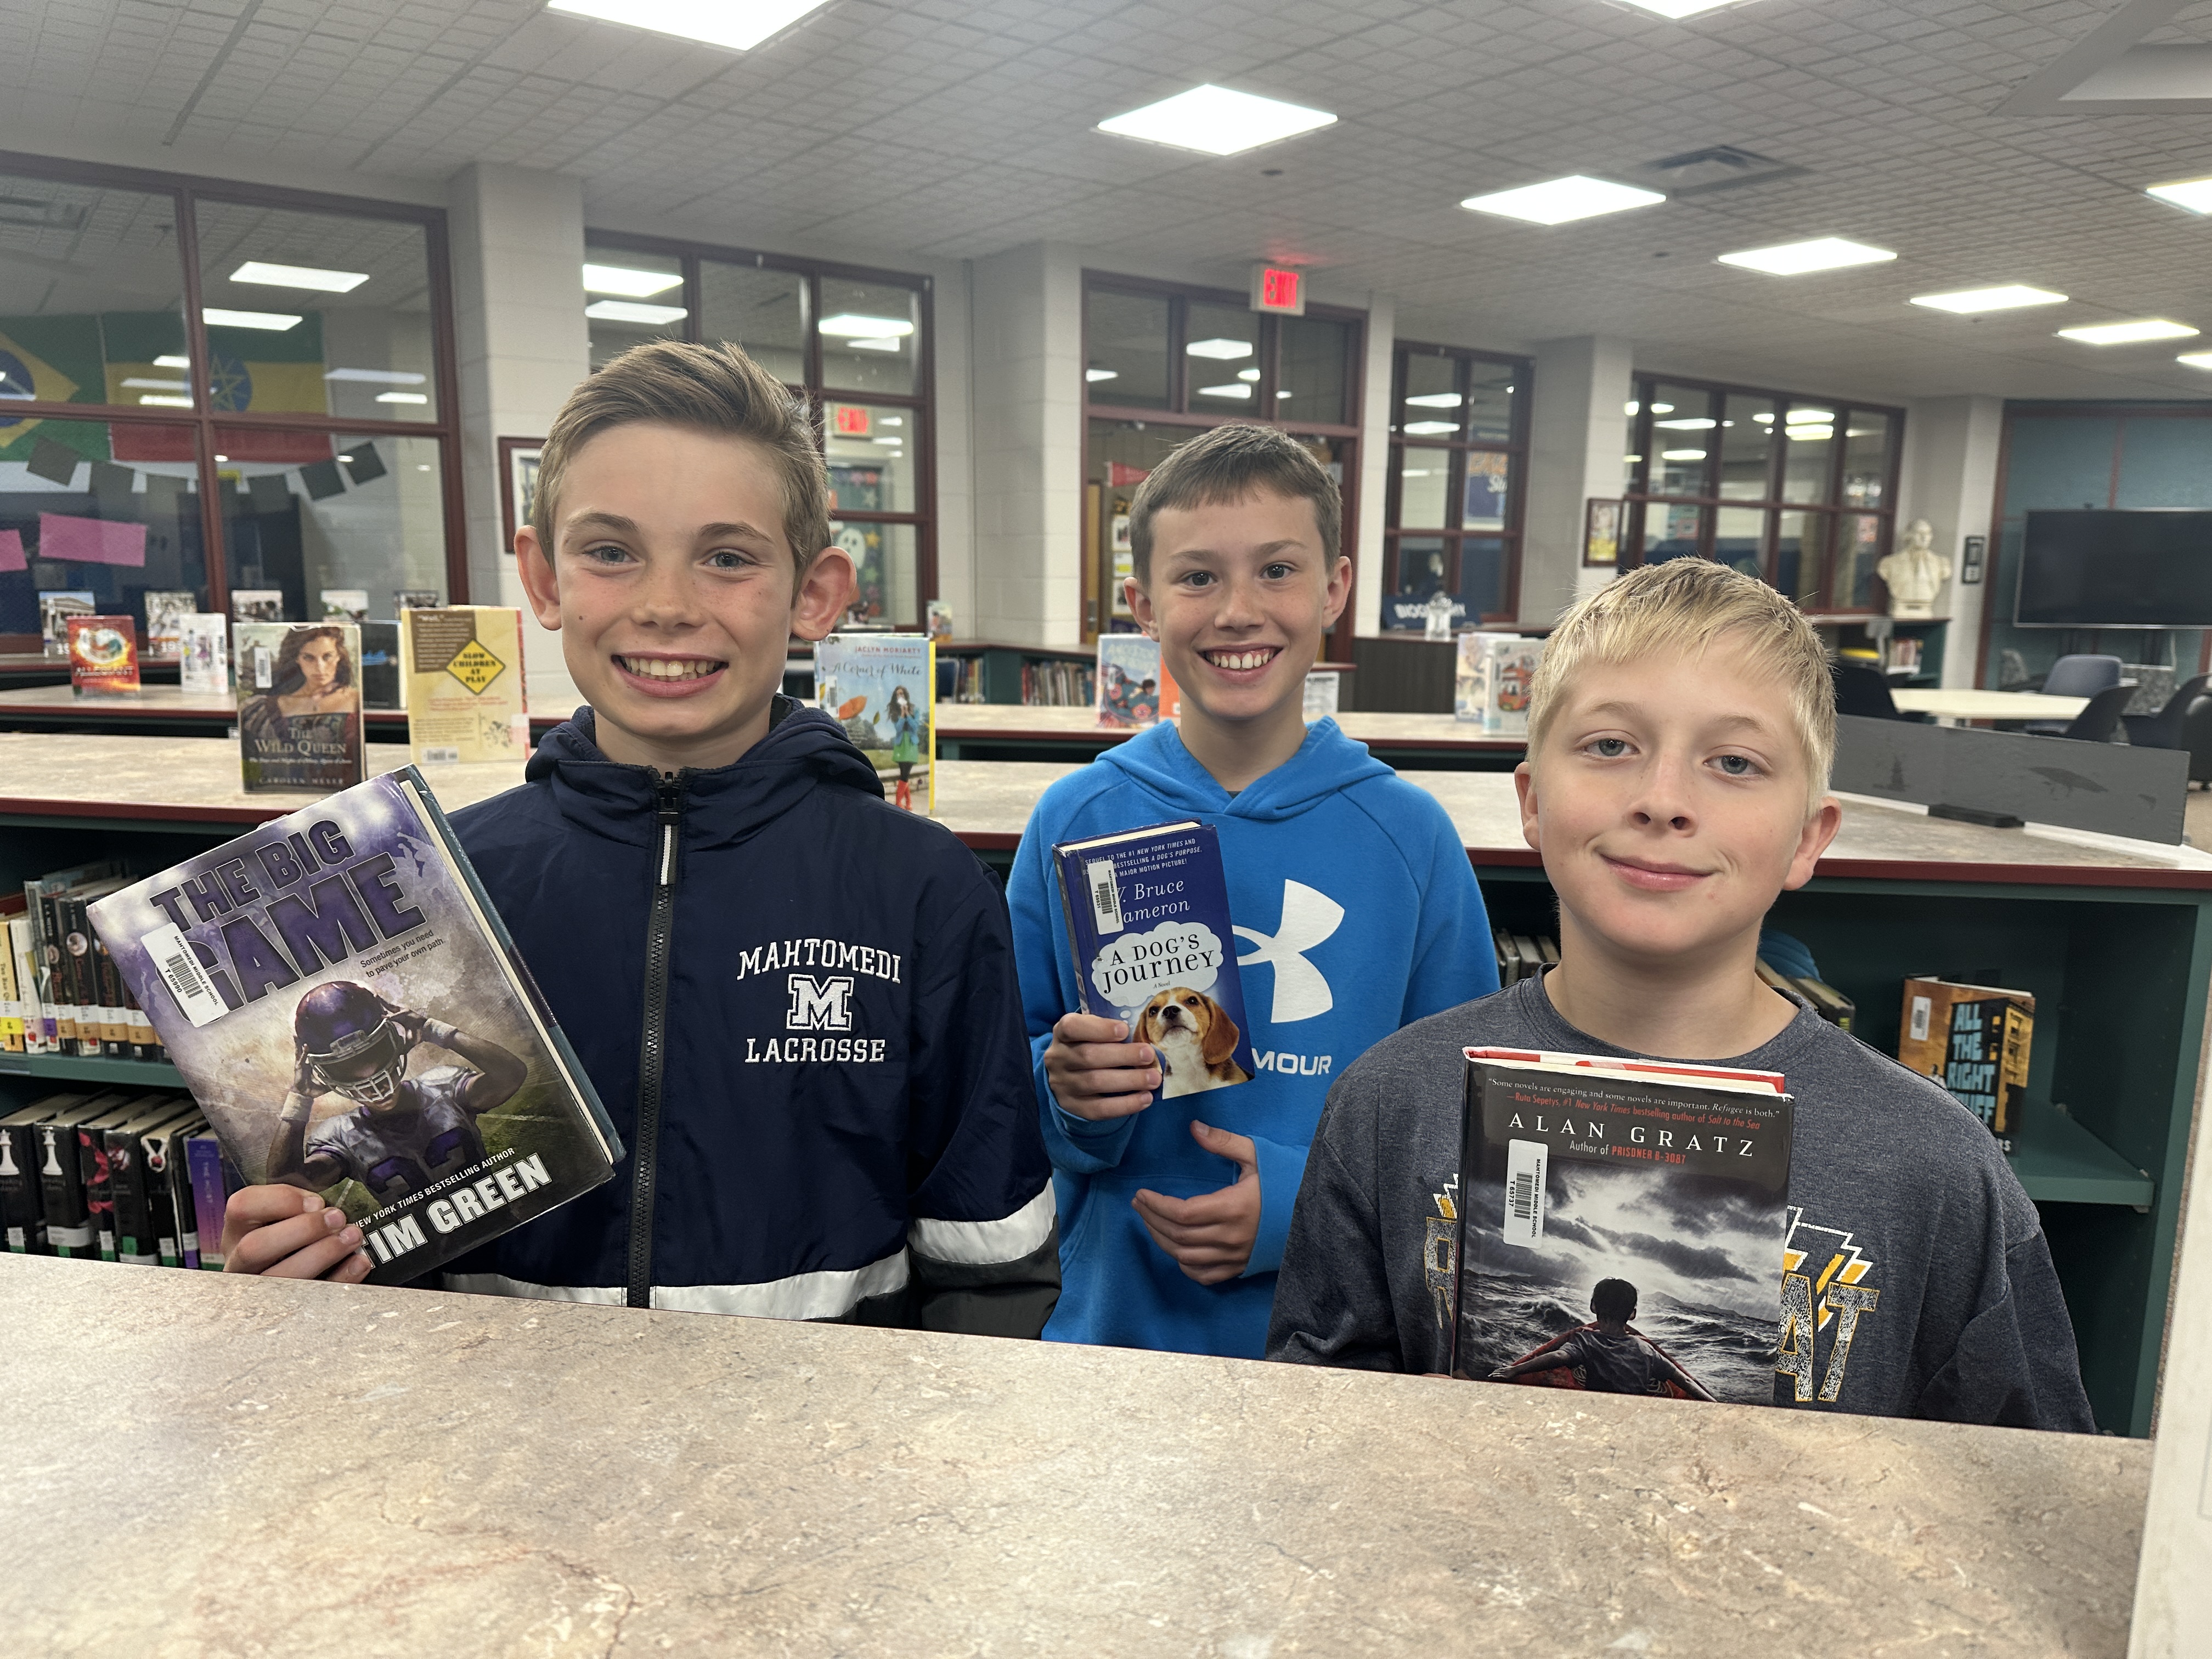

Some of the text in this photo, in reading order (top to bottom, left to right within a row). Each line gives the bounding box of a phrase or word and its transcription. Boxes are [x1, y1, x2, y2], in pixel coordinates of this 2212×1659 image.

[1263, 268, 1299, 309] EXIT
[465, 675, 487, 684] PLAY
[832, 662, 922, 680] A Corner of White
[255, 740, 347, 756] WILD QUEEN
[288, 727, 313, 740] THE
[1085, 857, 1105, 865] SEQUEL
[1151, 844, 1165, 853] YORK
[1167, 840, 1183, 849] TIMES
[1114, 856, 1149, 869] BESTSELLING
[1157, 852, 1173, 860] DOG'S
[149, 820, 356, 934] THE BIG
[1119, 868, 1137, 877] MAJOR
[1139, 864, 1160, 873] MOTION
[1162, 858, 1187, 868] PICTURE!
[1134, 880, 1184, 900] Bruce
[1123, 900, 1190, 923] ameron
[360, 929, 434, 968] Sometimes you need
[365, 970, 375, 978] to
[375, 962, 393, 976] pave
[393, 953, 410, 967] your
[410, 946, 427, 957] own
[737, 938, 901, 984] MAHTOMEDI
[1110, 950, 1126, 966] A
[173, 935, 219, 1006] MAHTOMEDI MIDDLE SCHOOL
[786, 973, 854, 1031] M
[1954, 1003, 1983, 1031] ALL
[744, 1037, 885, 1063] LACROSSE
[1953, 1031, 1983, 1061] THE
[1251, 1048, 1332, 1075] MOUR
[1948, 1062, 1996, 1093] RIGHT
[1488, 1078, 1513, 1088] “Some
[1515, 1082, 1538, 1091] novels
[1553, 1087, 1587, 1097] engaging
[1589, 1090, 1603, 1098] and
[1627, 1095, 1651, 1103] novels
[1668, 1098, 1710, 1110] important.
[1712, 1103, 1743, 1113] Refugee
[1746, 1107, 1752, 1115] is
[1532, 1094, 1561, 1108] Sepetys,
[1562, 1098, 1572, 1107] #1
[1575, 1099, 1590, 1109] New
[1593, 1102, 1608, 1112] York
[1611, 1104, 1630, 1114] Times
[1633, 1105, 1669, 1121] bestselling
[1672, 1111, 1695, 1122] author
[1697, 1114, 1706, 1123] of
[1708, 1114, 1722, 1125] Salt
[1724, 1117, 1731, 1125] to
[1733, 1117, 1744, 1127] the
[1746, 1119, 1760, 1130] Sea
[1508, 1113, 1753, 1157] ALAN GRATZ
[1569, 1139, 1596, 1154] Author
[1599, 1144, 1610, 1155] of
[1611, 1147, 1652, 1160] PRISONER
[373, 1204, 397, 1220] YORK
[397, 1191, 425, 1209] TIMES
[424, 1164, 481, 1197] BESTSELLING
[481, 1147, 515, 1169] AUTHOR
[426, 1152, 552, 1234] GREEN
